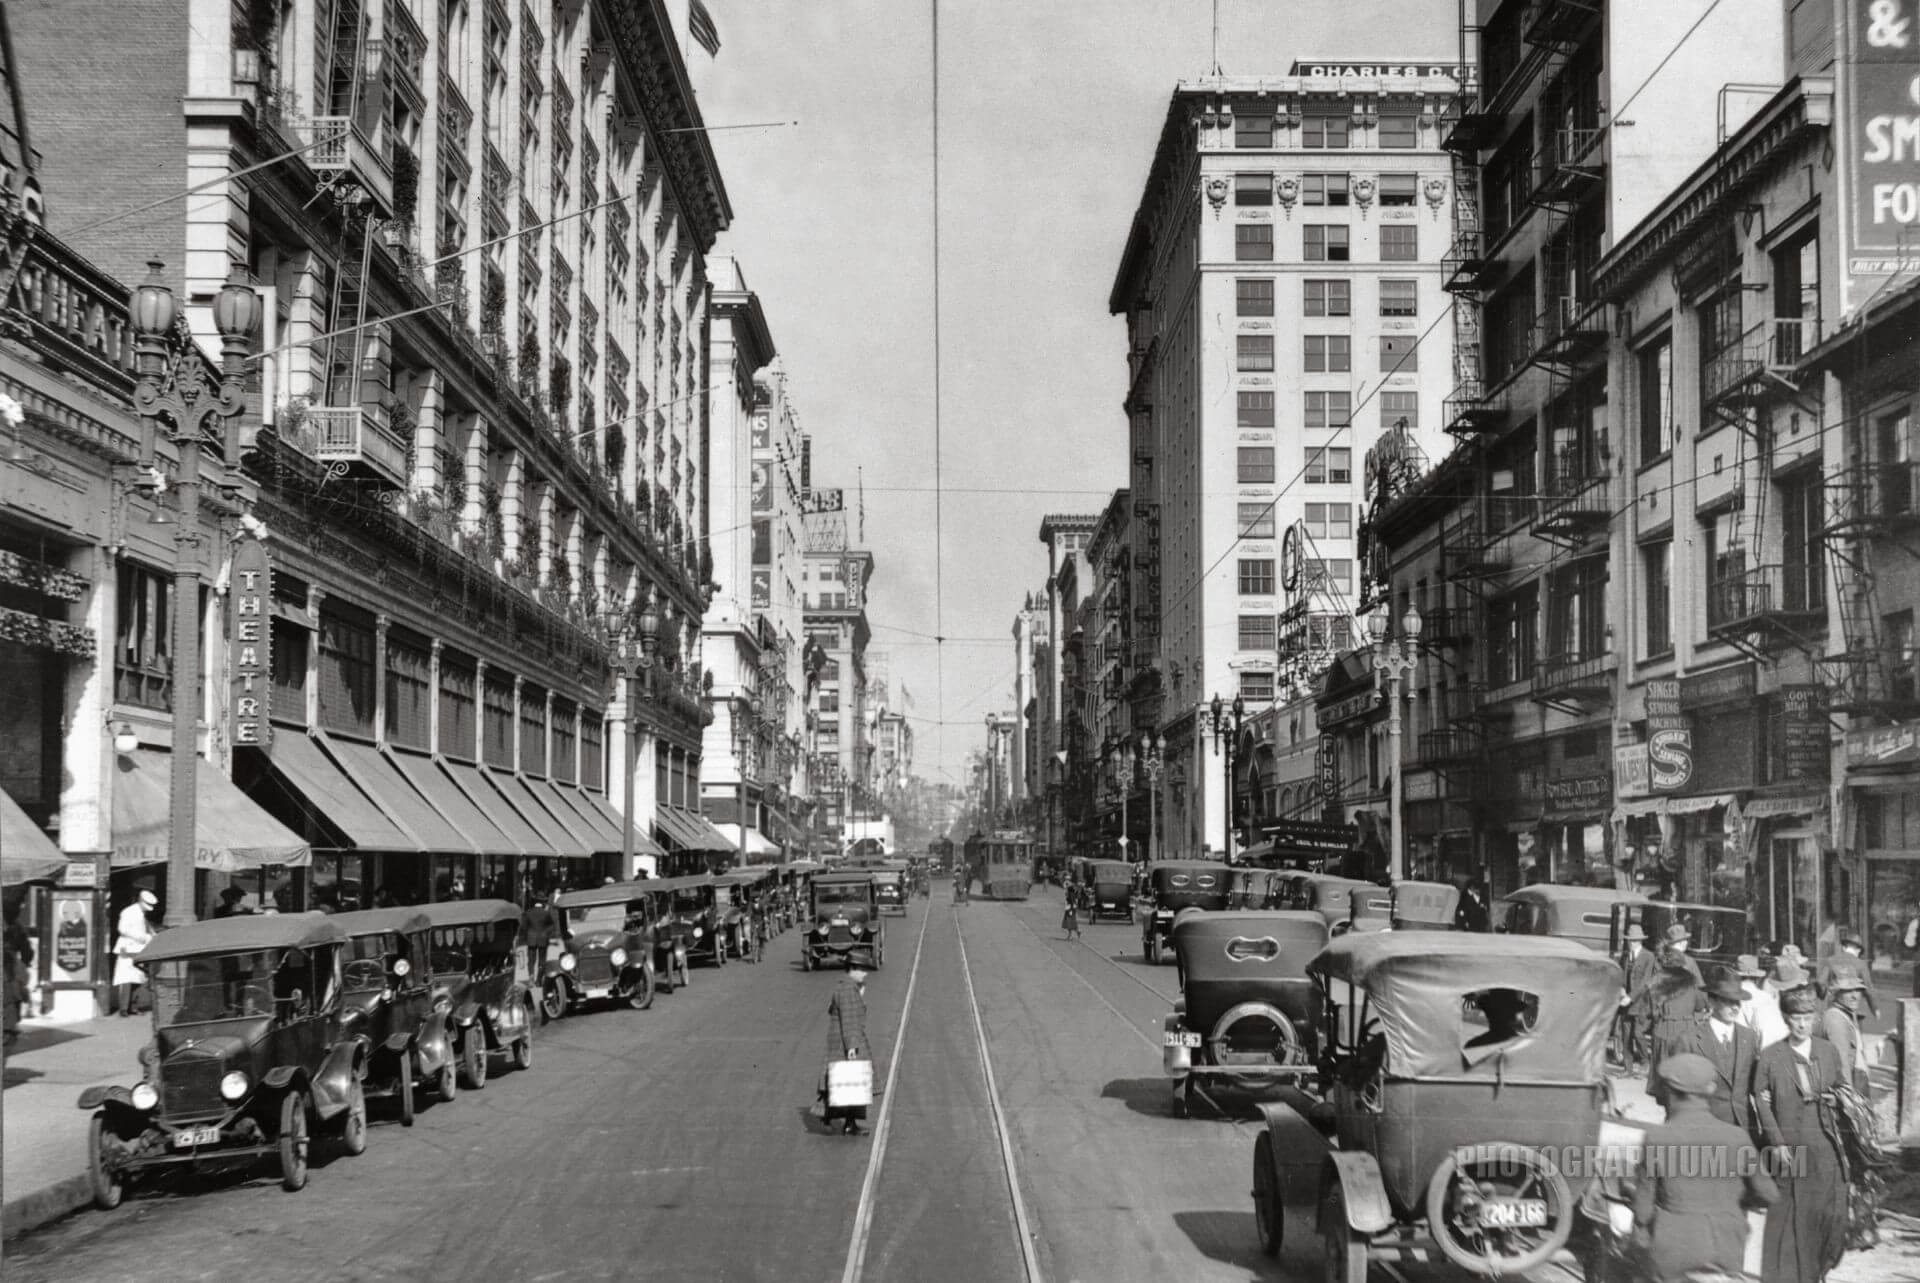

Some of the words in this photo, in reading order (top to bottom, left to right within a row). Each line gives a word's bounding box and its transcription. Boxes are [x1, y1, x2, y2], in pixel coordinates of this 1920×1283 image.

[1867, 0, 1911, 48] &
[1310, 66, 1419, 78] CHARLES
[1873, 183, 1920, 225] FO
[237, 569, 261, 743] THEATRE
[1647, 681, 1680, 699] SINGER
[1648, 702, 1680, 715] SEWING
[1322, 738, 1334, 795] FURS
[115, 844, 222, 864] MILLRY
